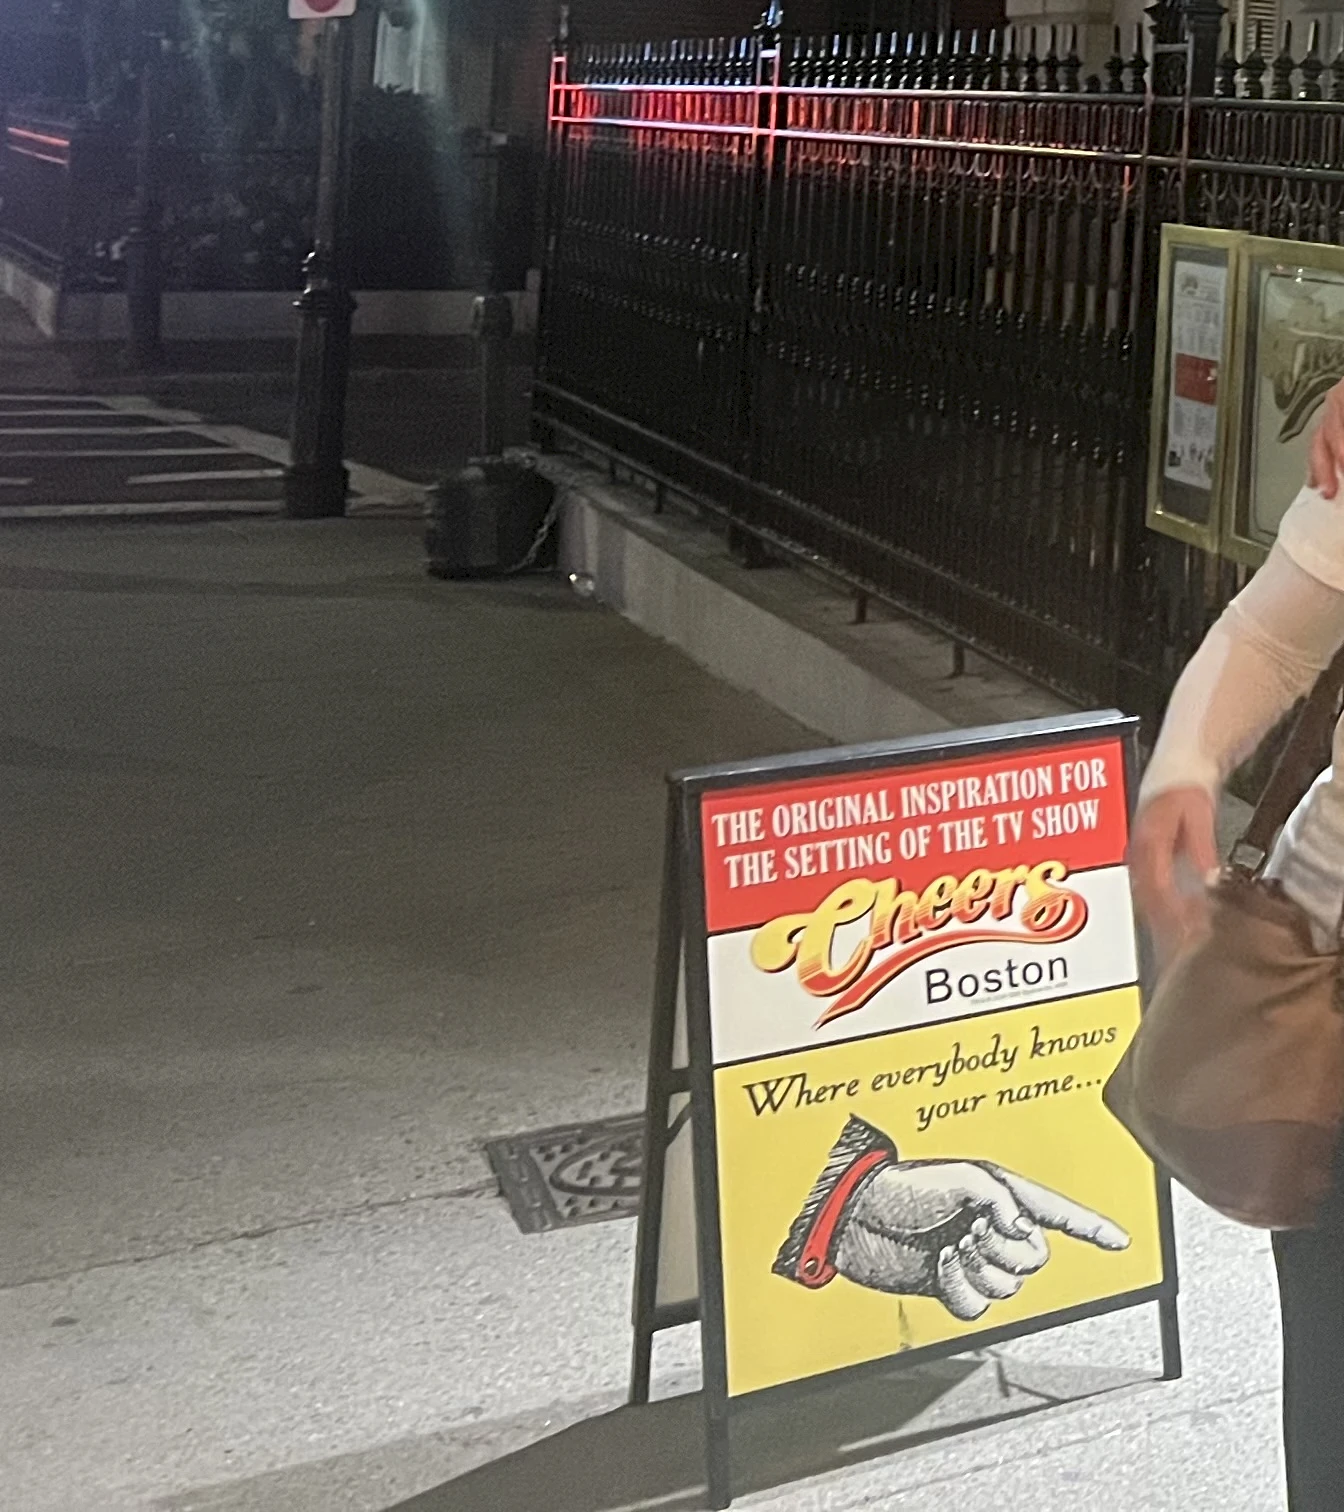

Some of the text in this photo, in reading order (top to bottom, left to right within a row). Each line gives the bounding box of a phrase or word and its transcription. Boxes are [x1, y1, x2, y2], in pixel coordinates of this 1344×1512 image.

[711, 758, 1108, 847] THE ORIGINAL INSPIRATION FOR
[724, 798, 1101, 889] THE SETTING OF THE TV SHOW
[750, 860, 1089, 1031] Cheers
[925, 956, 1068, 1005] Boston
[742, 1025, 1118, 1117] Where everybody knows
[915, 1071, 1103, 1132] your name...
